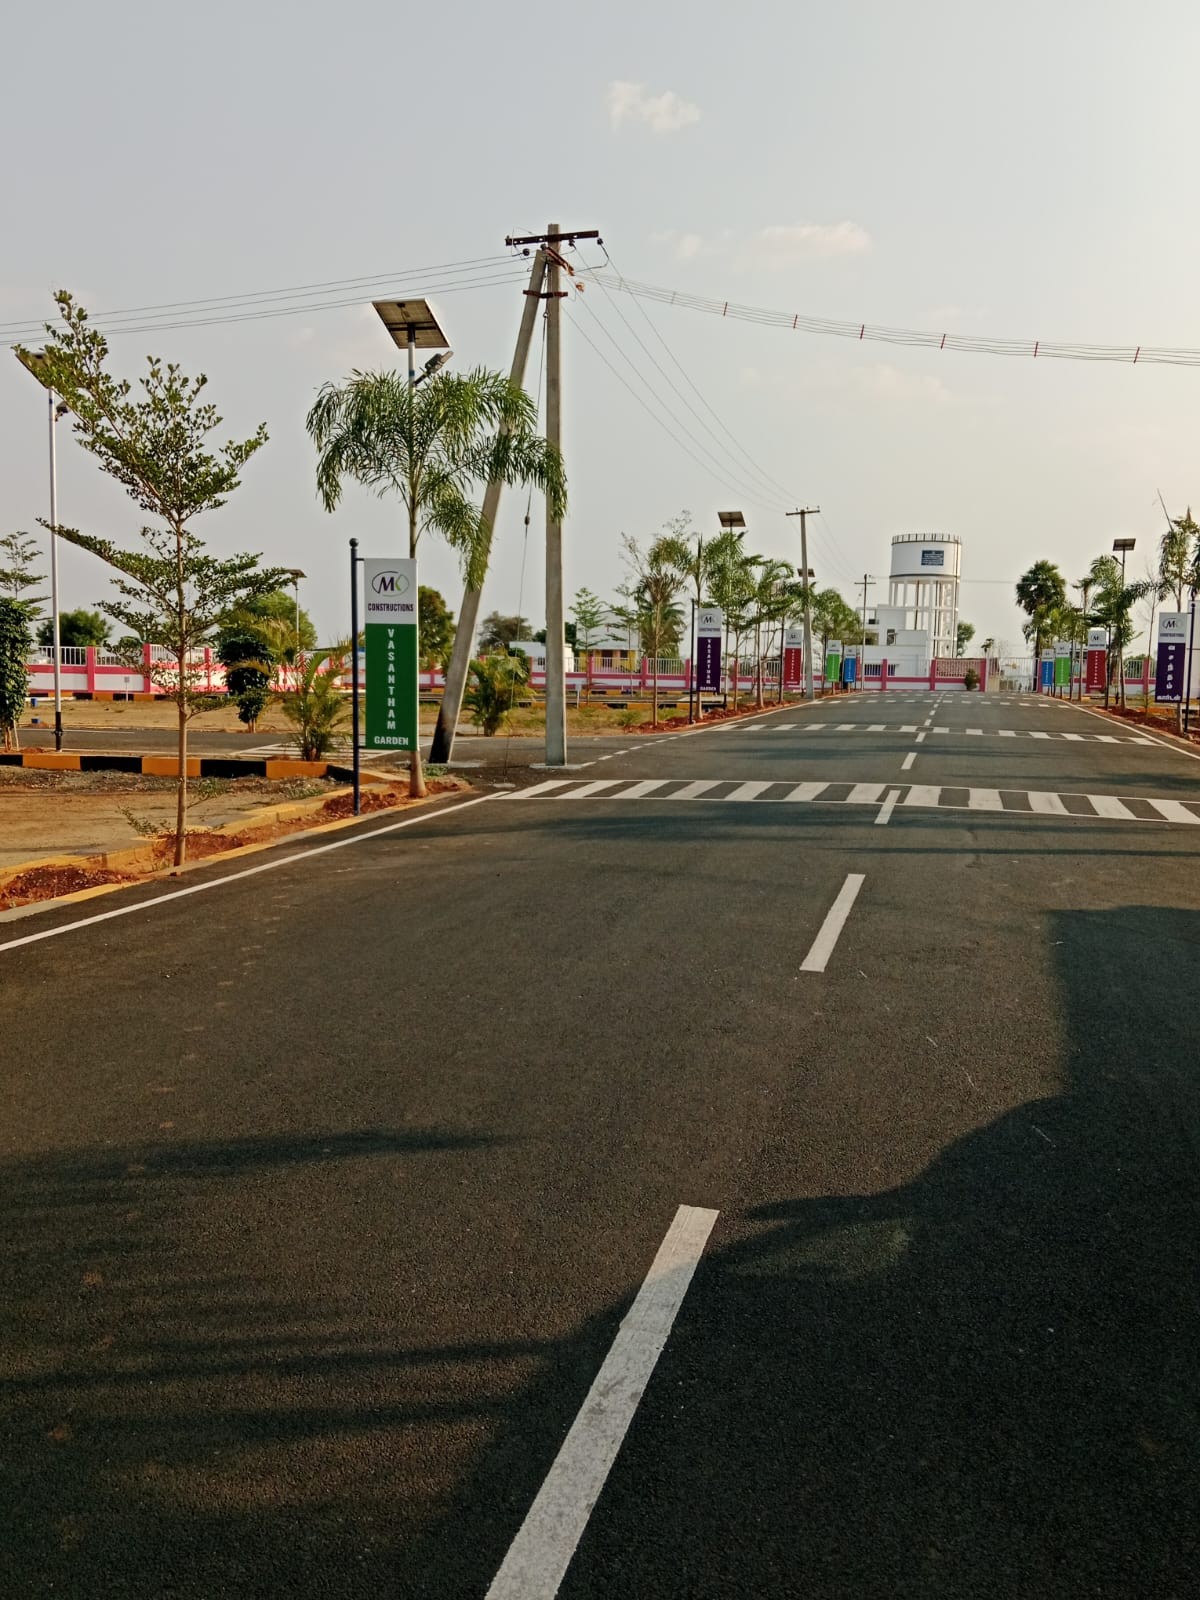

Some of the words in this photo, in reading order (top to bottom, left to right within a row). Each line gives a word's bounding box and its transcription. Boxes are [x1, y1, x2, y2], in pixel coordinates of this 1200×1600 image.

[367, 603, 414, 612] CONSTRUCTIONS
[387, 628, 396, 730] VASANTHAM
[374, 736, 409, 746] GARDEN
